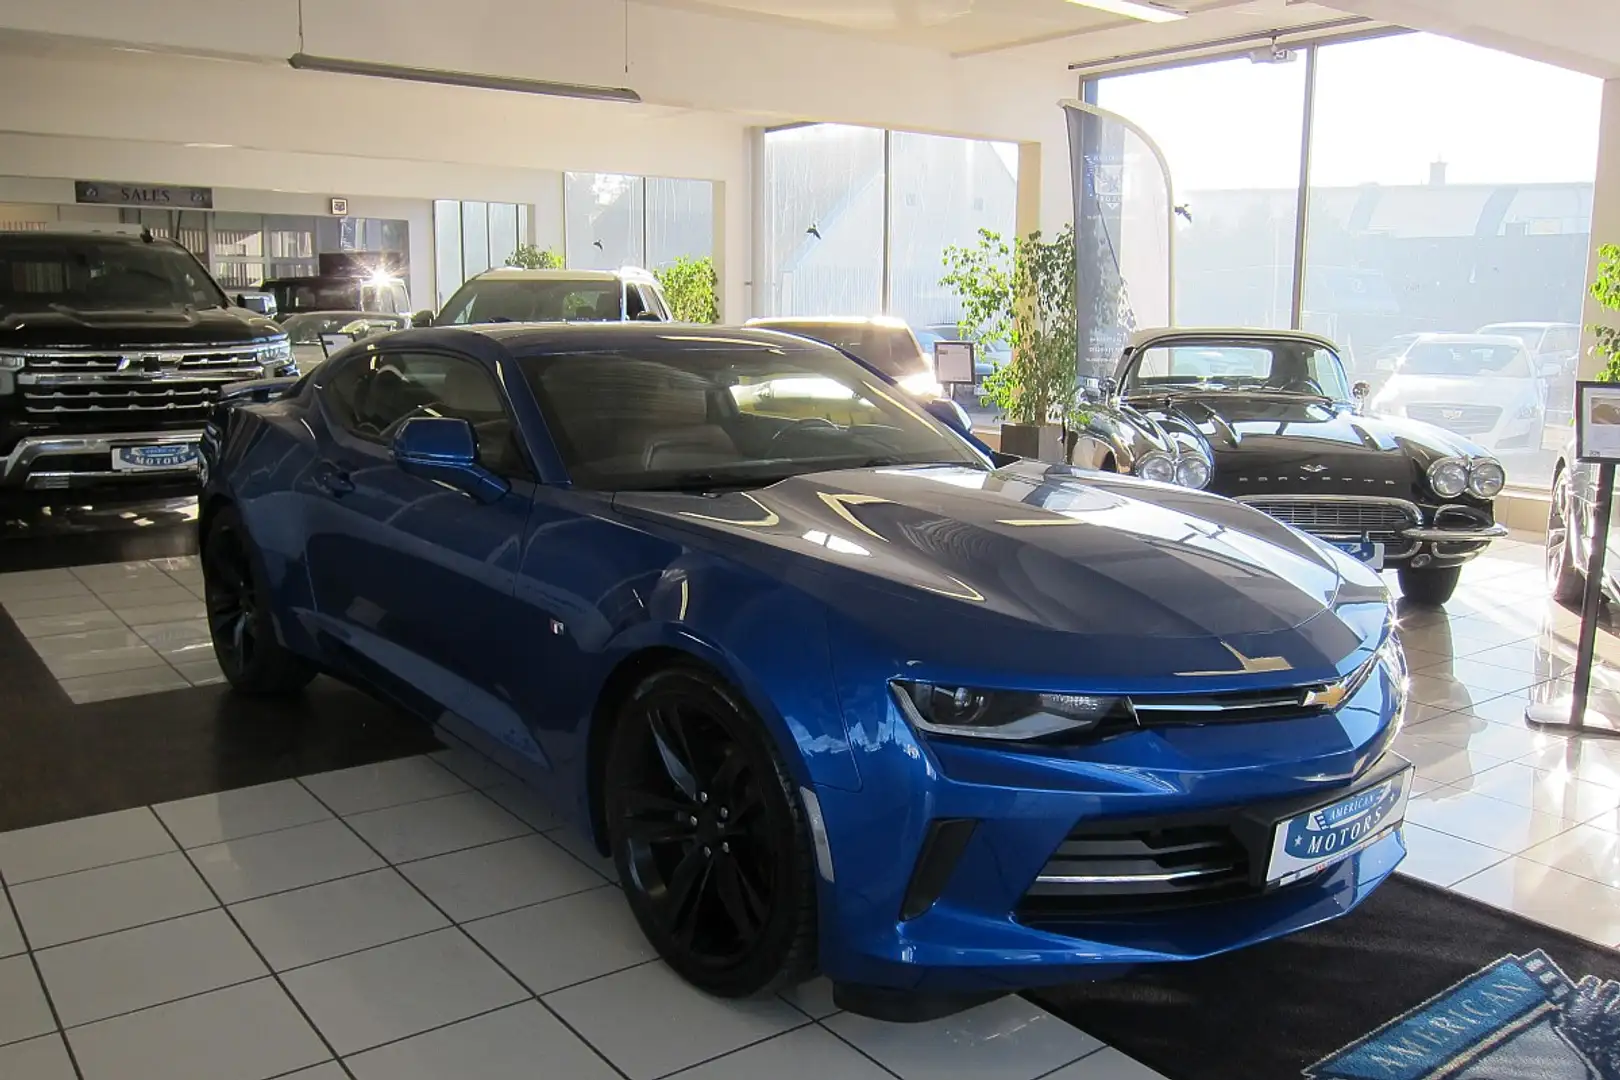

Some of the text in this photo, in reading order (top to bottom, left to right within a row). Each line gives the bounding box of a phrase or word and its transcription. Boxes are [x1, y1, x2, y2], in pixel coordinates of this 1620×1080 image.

[121, 187, 170, 203] SALES
[136, 455, 186, 465] MOTORS
[1239, 476, 1395, 485] CORVETTE
[1330, 794, 1374, 820] AMERICAN
[1307, 806, 1382, 854] MOTORS
[1369, 978, 1531, 1075] AMERICAN
